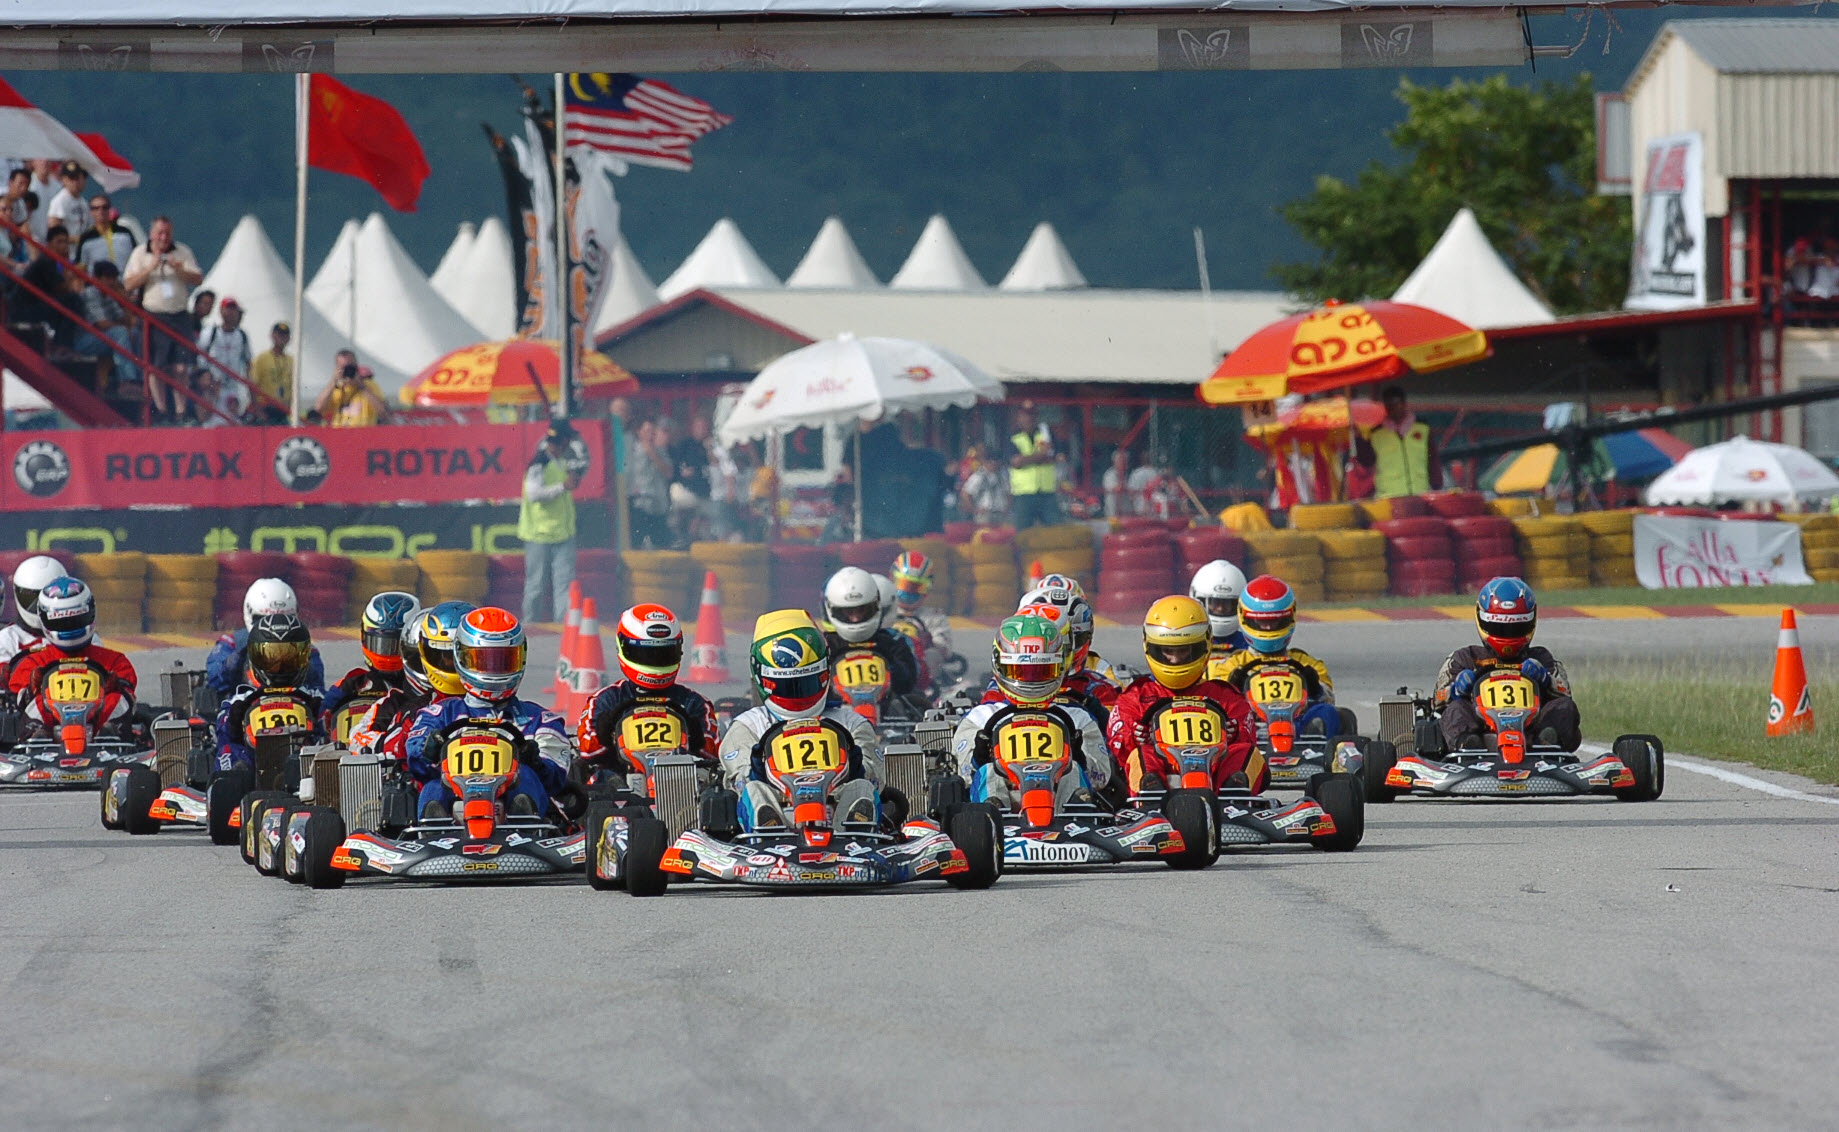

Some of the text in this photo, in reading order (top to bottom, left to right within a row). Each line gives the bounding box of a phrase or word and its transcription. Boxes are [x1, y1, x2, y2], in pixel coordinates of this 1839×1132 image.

[105, 451, 244, 481] ROTAX
[366, 447, 504, 477] ROTAX
[1023, 645, 1041, 653] TKP
[1258, 680, 1294, 700] 137
[1487, 684, 1528, 707] 131
[635, 722, 673, 745] 122
[1169, 717, 1213, 743] 118
[1008, 732, 1053, 760] 112
[782, 739, 831, 770] 121
[454, 749, 500, 775] 101
[1388, 774, 1413, 784] CRG
[151, 806, 176, 816] CRG
[1309, 821, 1334, 831] CRG
[1157, 839, 1183, 849] CRG
[333, 855, 362, 866] CRG
[462, 862, 499, 871] CRG
[663, 857, 694, 870] CRG
[939, 859, 967, 870] CRG
[799, 872, 835, 880] CRG
